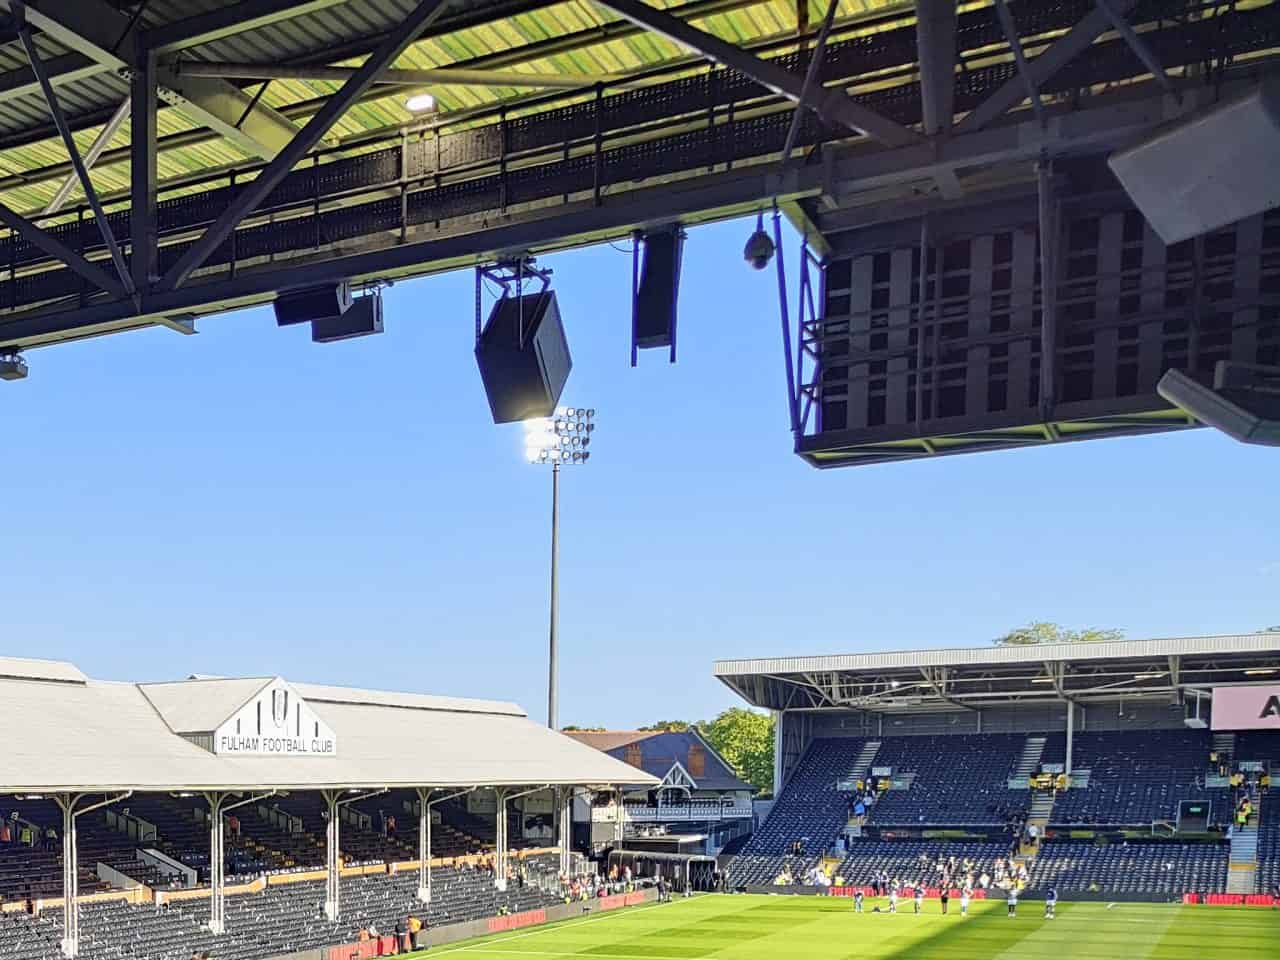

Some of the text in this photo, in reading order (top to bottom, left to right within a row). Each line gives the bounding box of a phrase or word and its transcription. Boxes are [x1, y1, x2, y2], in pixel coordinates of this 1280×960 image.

[1258, 695, 1280, 719] A
[221, 736, 333, 753] FULHAM FOOTBALL CLUB
